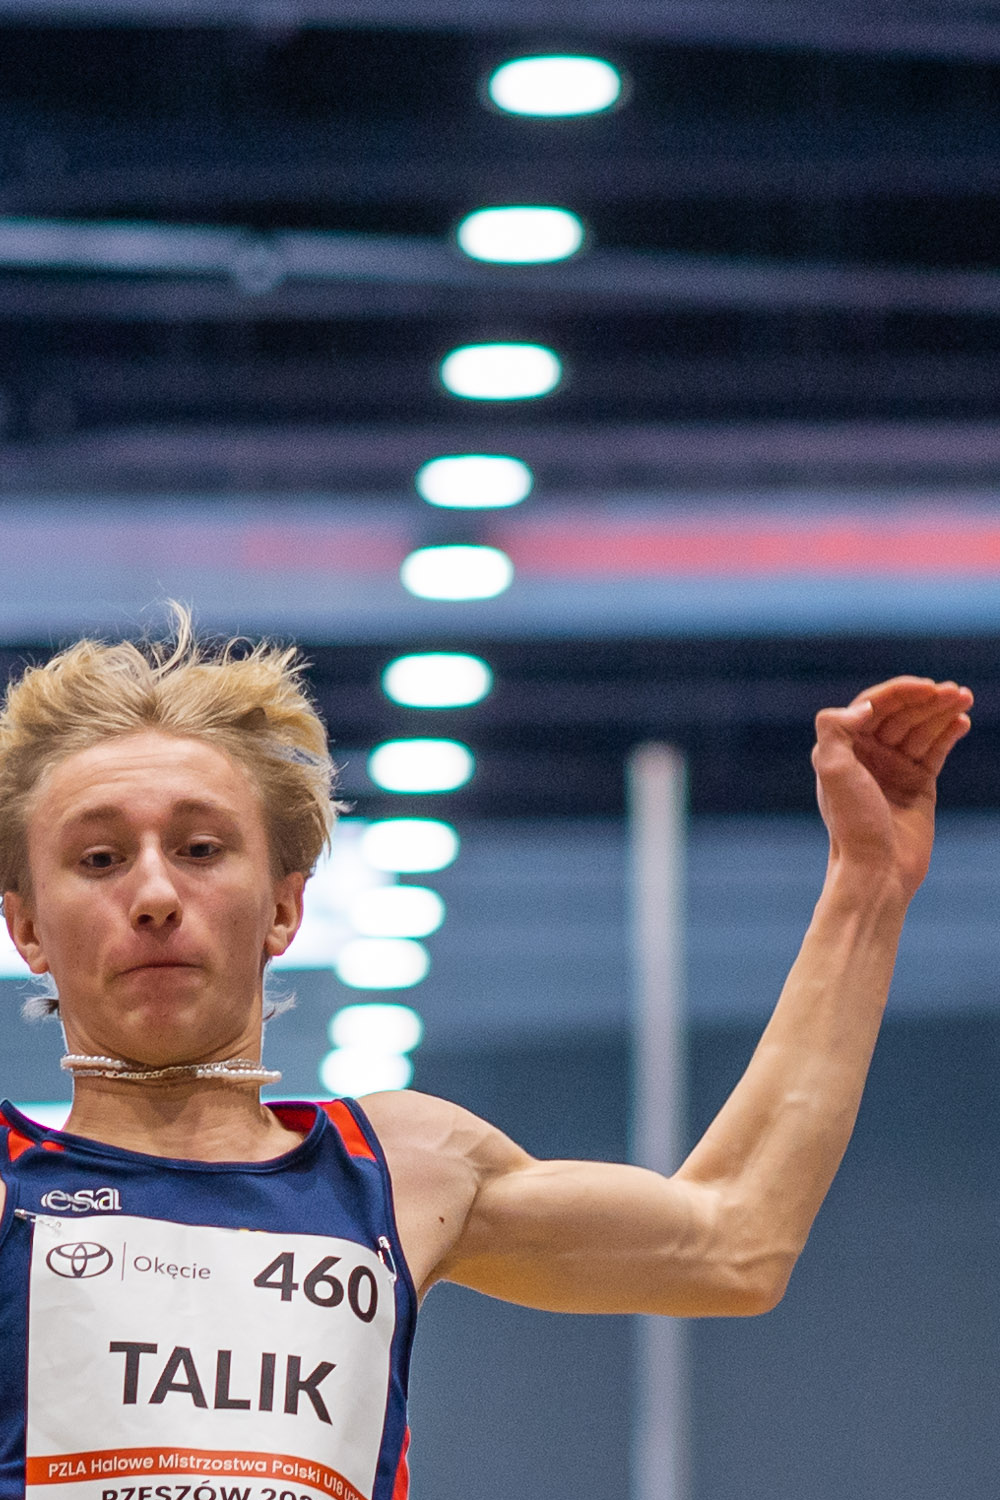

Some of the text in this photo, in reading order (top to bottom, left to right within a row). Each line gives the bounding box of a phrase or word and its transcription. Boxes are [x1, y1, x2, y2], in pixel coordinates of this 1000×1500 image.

[133, 1255, 211, 1280] Okęcie
[253, 1251, 378, 1323] 460
[109, 1341, 337, 1425] TALIK
[48, 1460, 87, 1478] PZLA
[90, 1456, 154, 1474] Halowe
[158, 1453, 267, 1472] Mistrzostwa
[271, 1460, 320, 1484] Polski
[323, 1473, 343, 1496] U18
